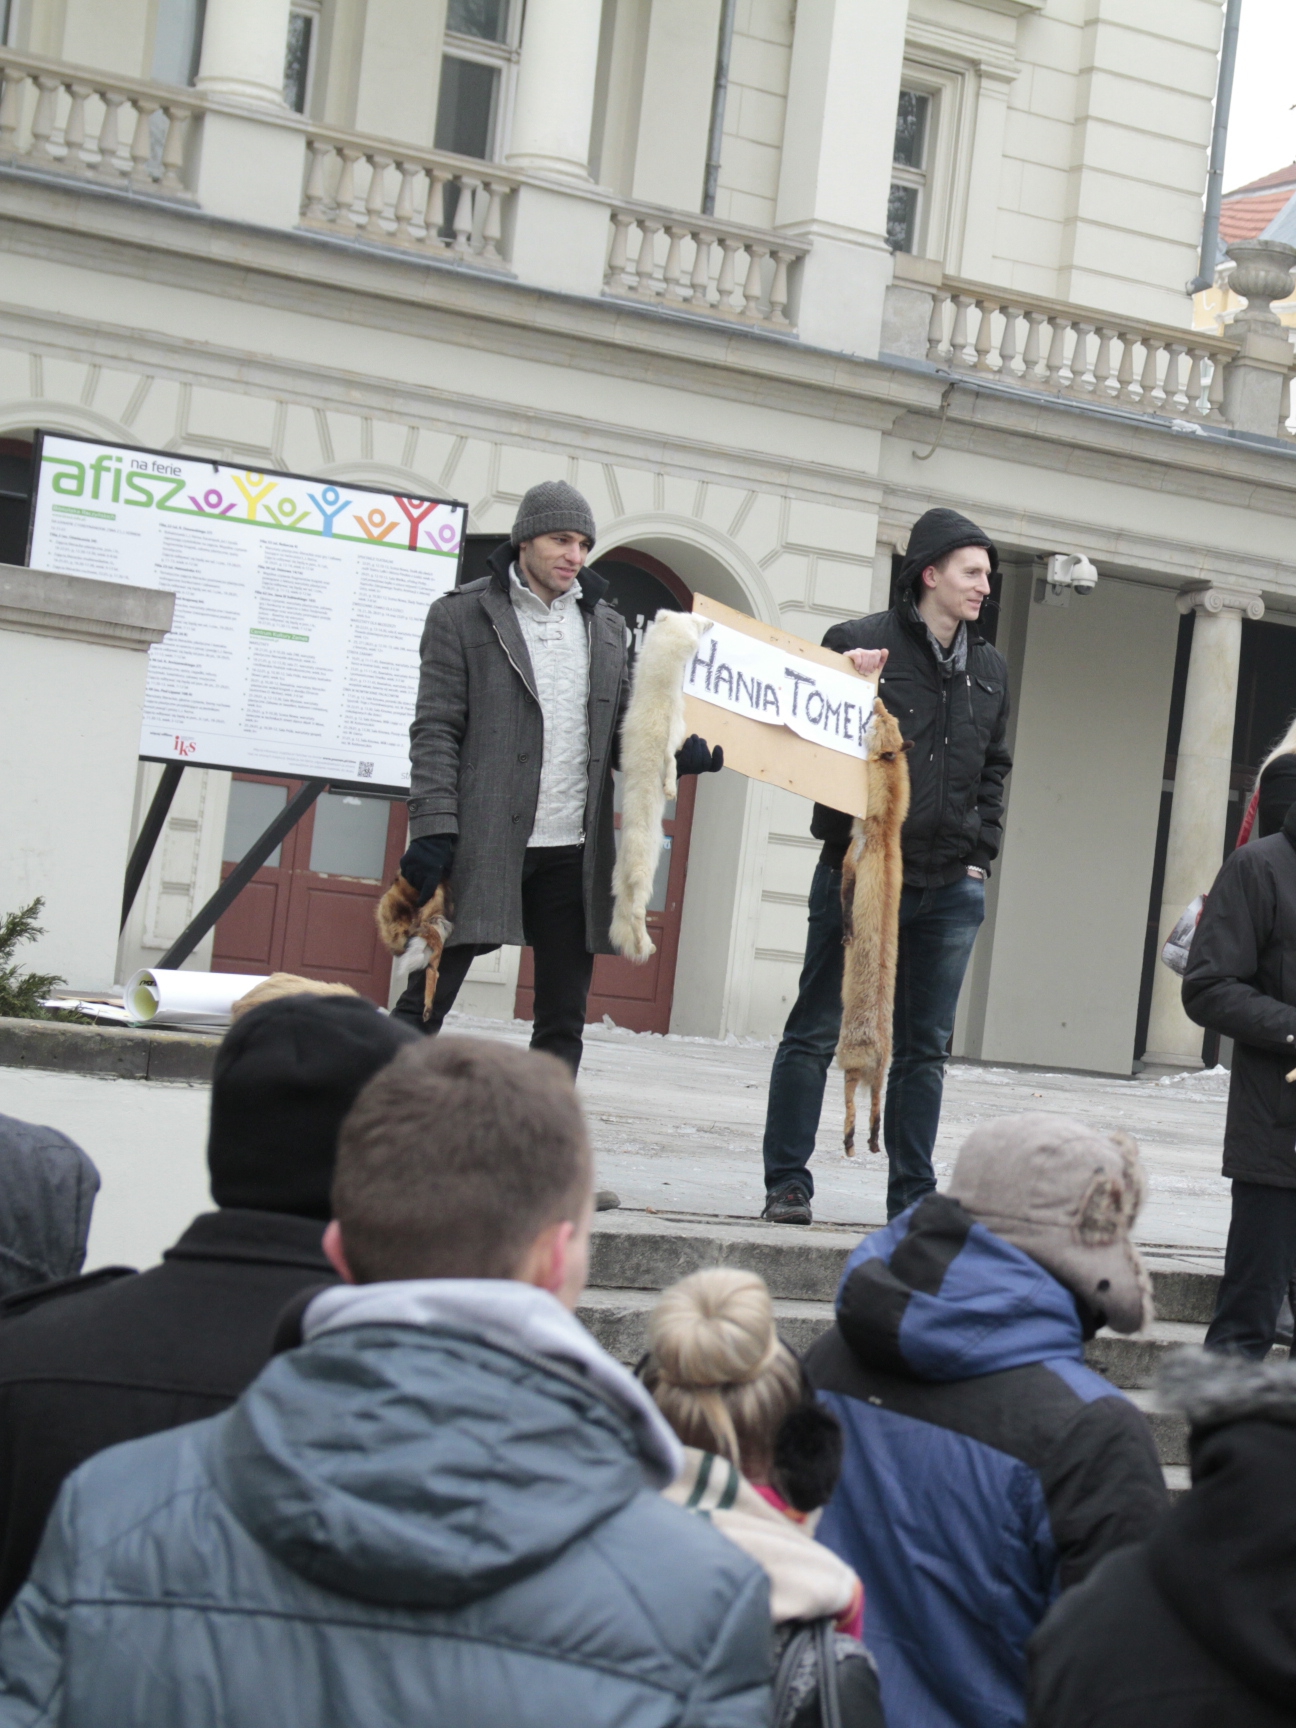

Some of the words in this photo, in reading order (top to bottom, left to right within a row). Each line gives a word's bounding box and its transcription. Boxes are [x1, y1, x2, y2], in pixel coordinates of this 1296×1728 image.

[51, 454, 187, 511] afisz
[130, 459, 148, 471] na
[152, 460, 182, 477] ferie
[689, 638, 780, 717] HANIA
[784, 667, 874, 747] TOMEK
